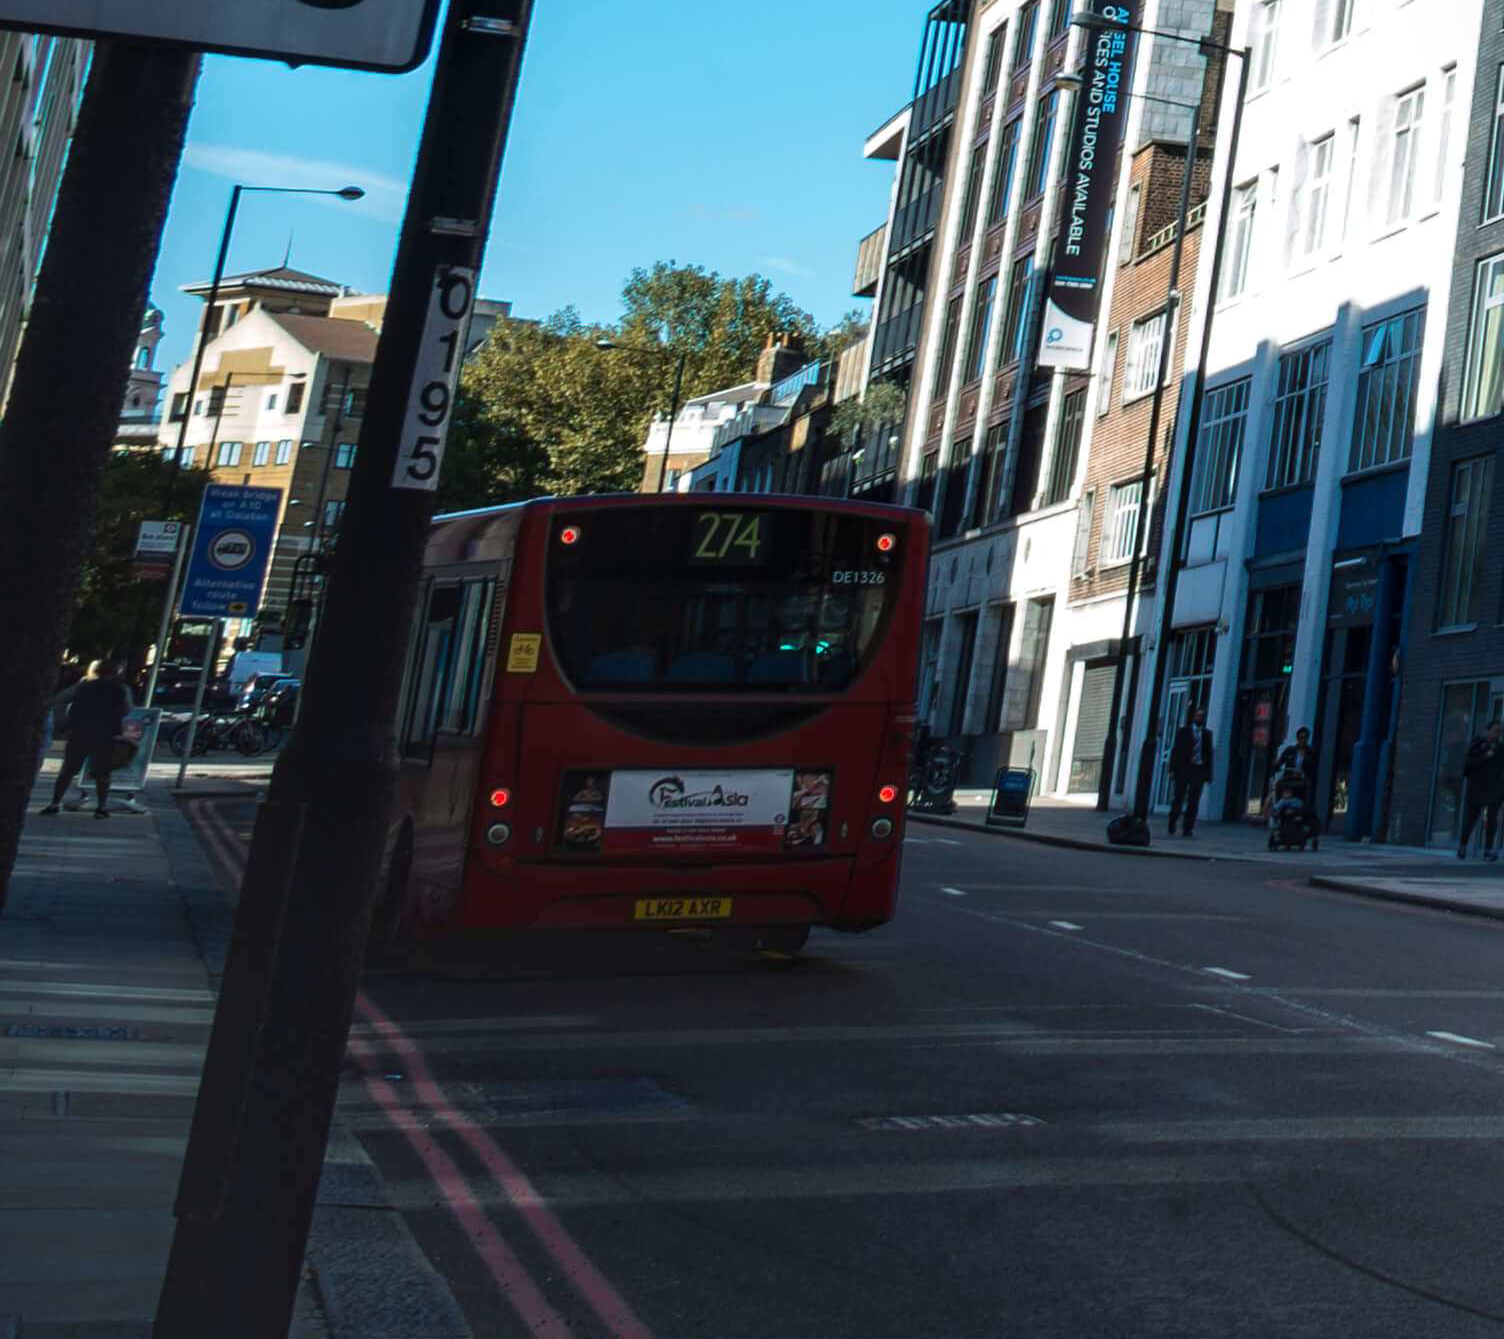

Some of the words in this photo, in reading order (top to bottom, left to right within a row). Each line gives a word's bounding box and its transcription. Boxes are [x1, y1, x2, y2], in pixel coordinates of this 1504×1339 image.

[1094, 6, 1116, 67] OICES
[1110, 6, 1129, 58] AGEL
[1089, 70, 1106, 103] AND
[1102, 61, 1121, 114] HOUSE
[1079, 106, 1101, 171] STUDIOS
[1065, 172, 1092, 256] AVAILABLE
[407, 271, 470, 481] 0195
[695, 512, 762, 560] 274
[832, 570, 886, 585] DE1326
[646, 901, 682, 917] LK12
[688, 900, 721, 916] AXR
